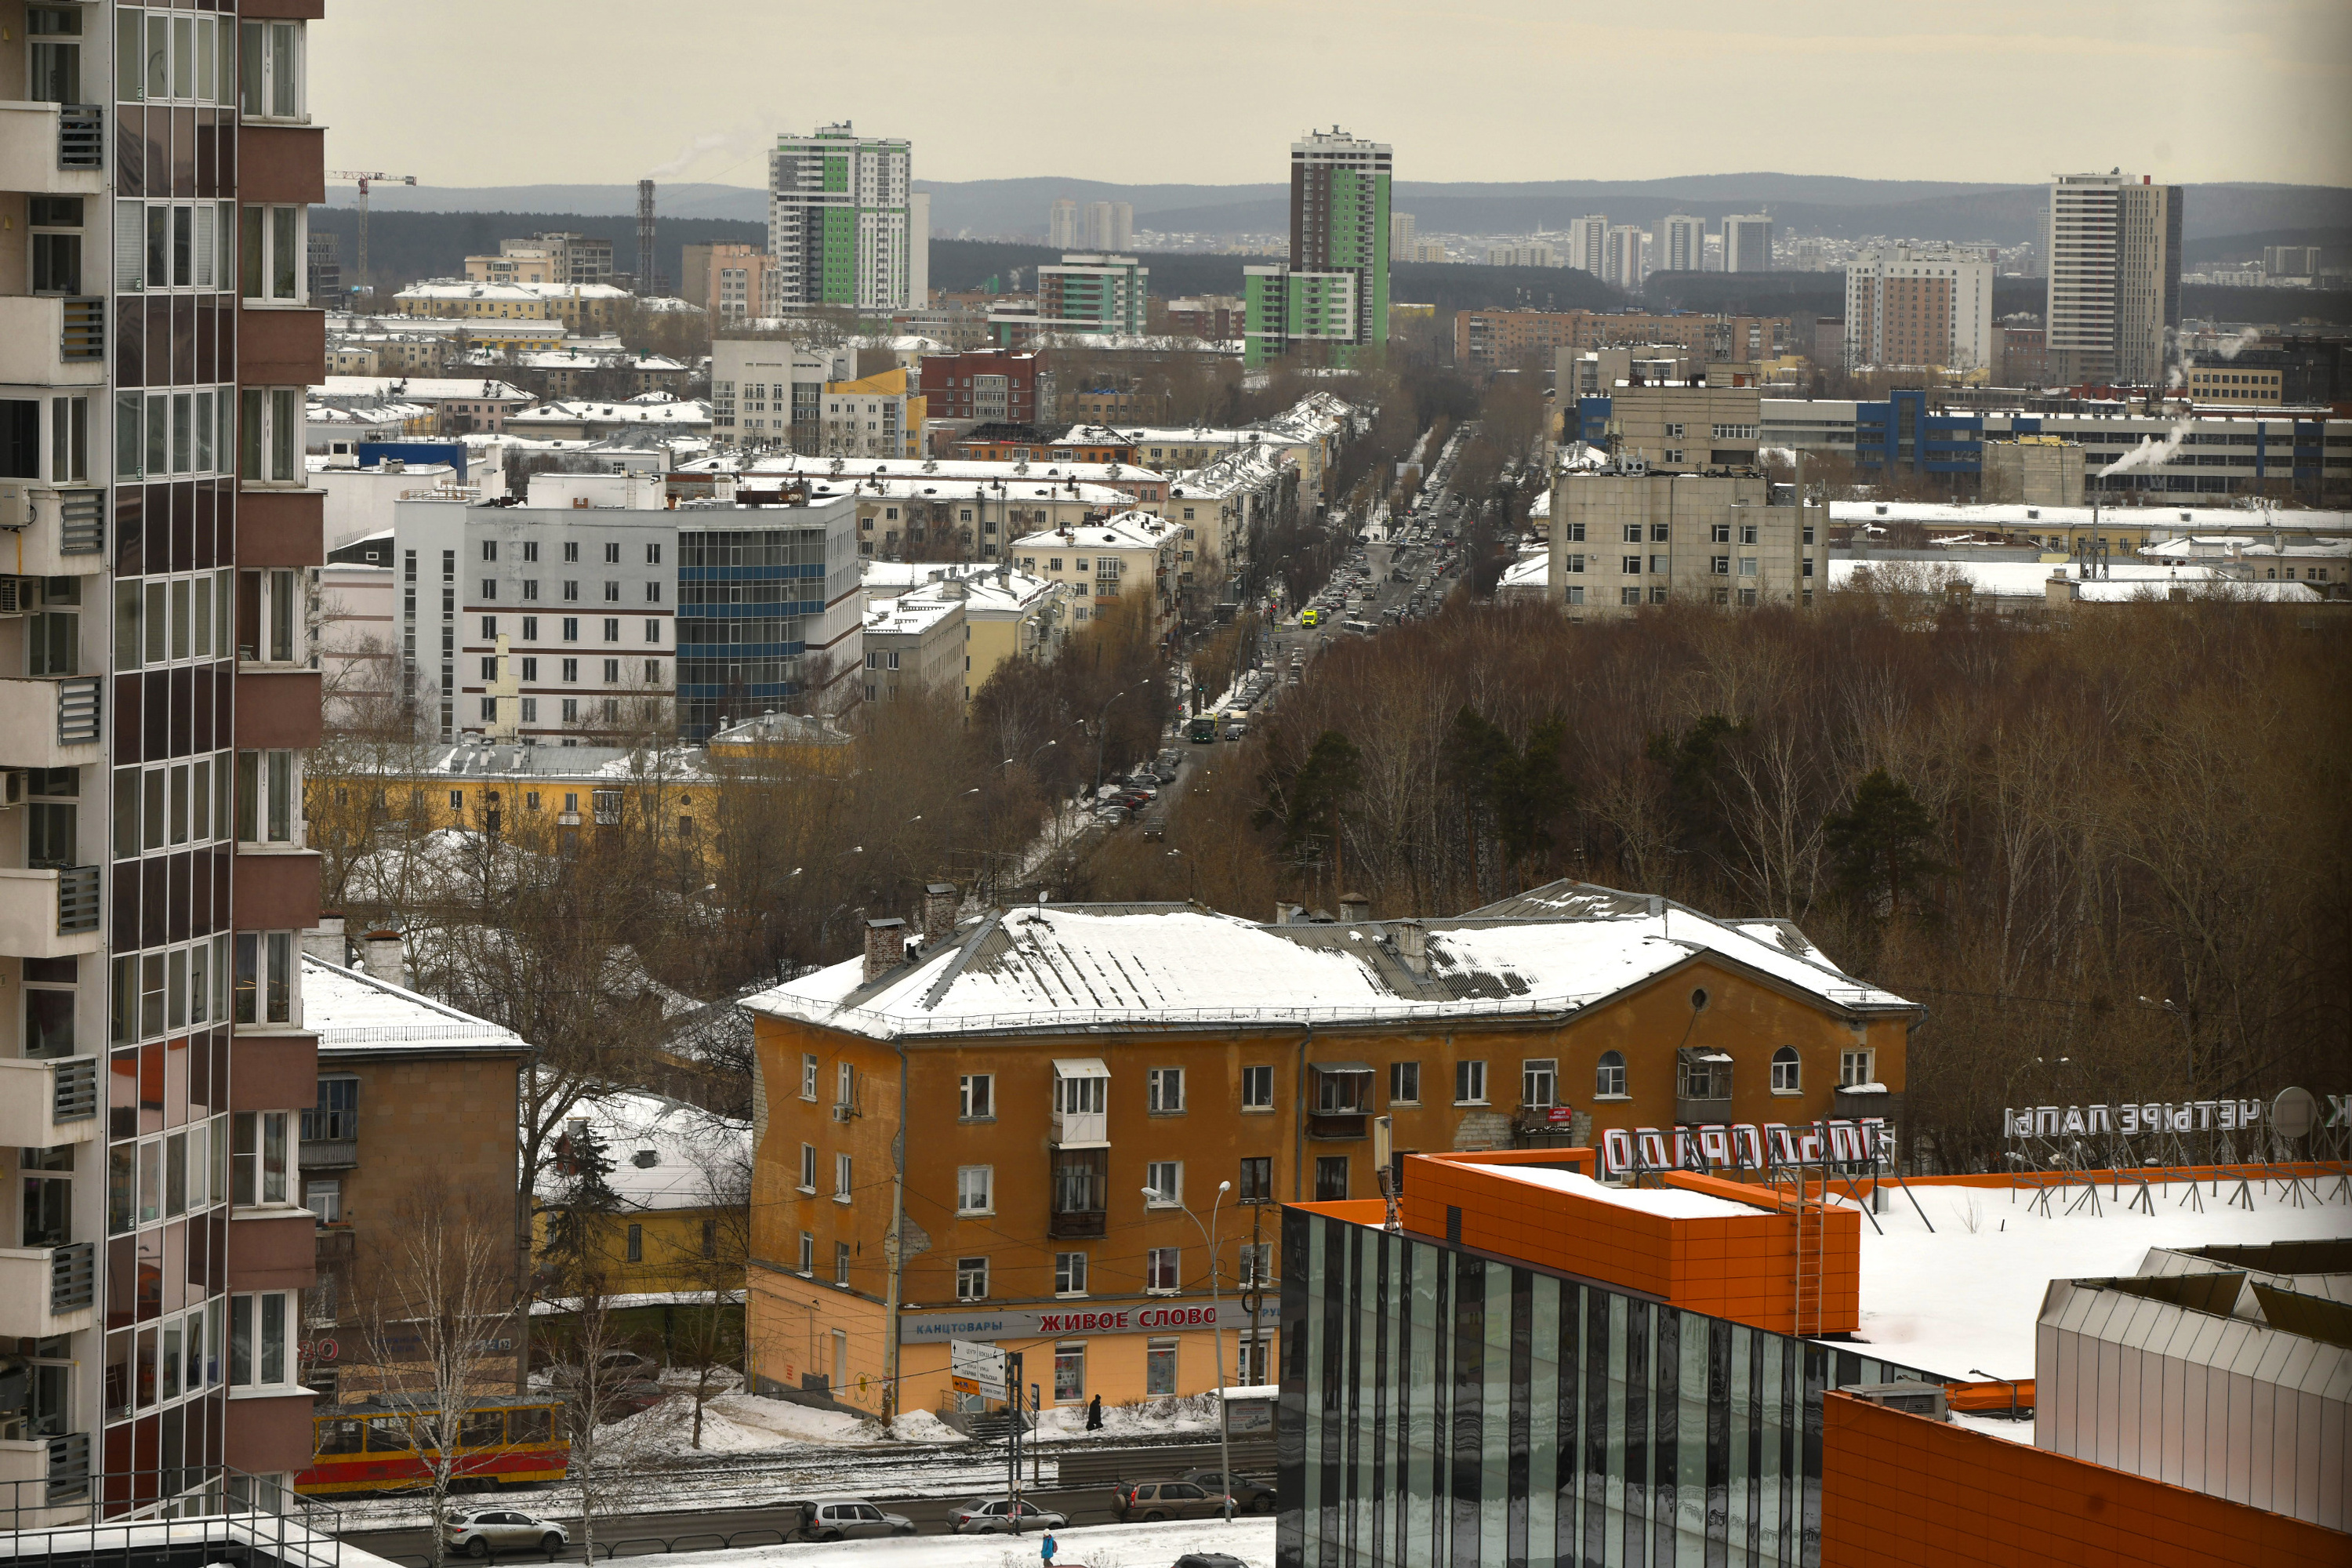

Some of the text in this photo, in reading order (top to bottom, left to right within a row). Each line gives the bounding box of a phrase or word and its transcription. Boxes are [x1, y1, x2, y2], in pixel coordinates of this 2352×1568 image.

[917, 1322, 1003, 1334] КАНЦТОВАРЫ
[1038, 1307, 1216, 1332] ЖИВОЕ СЛОВО
